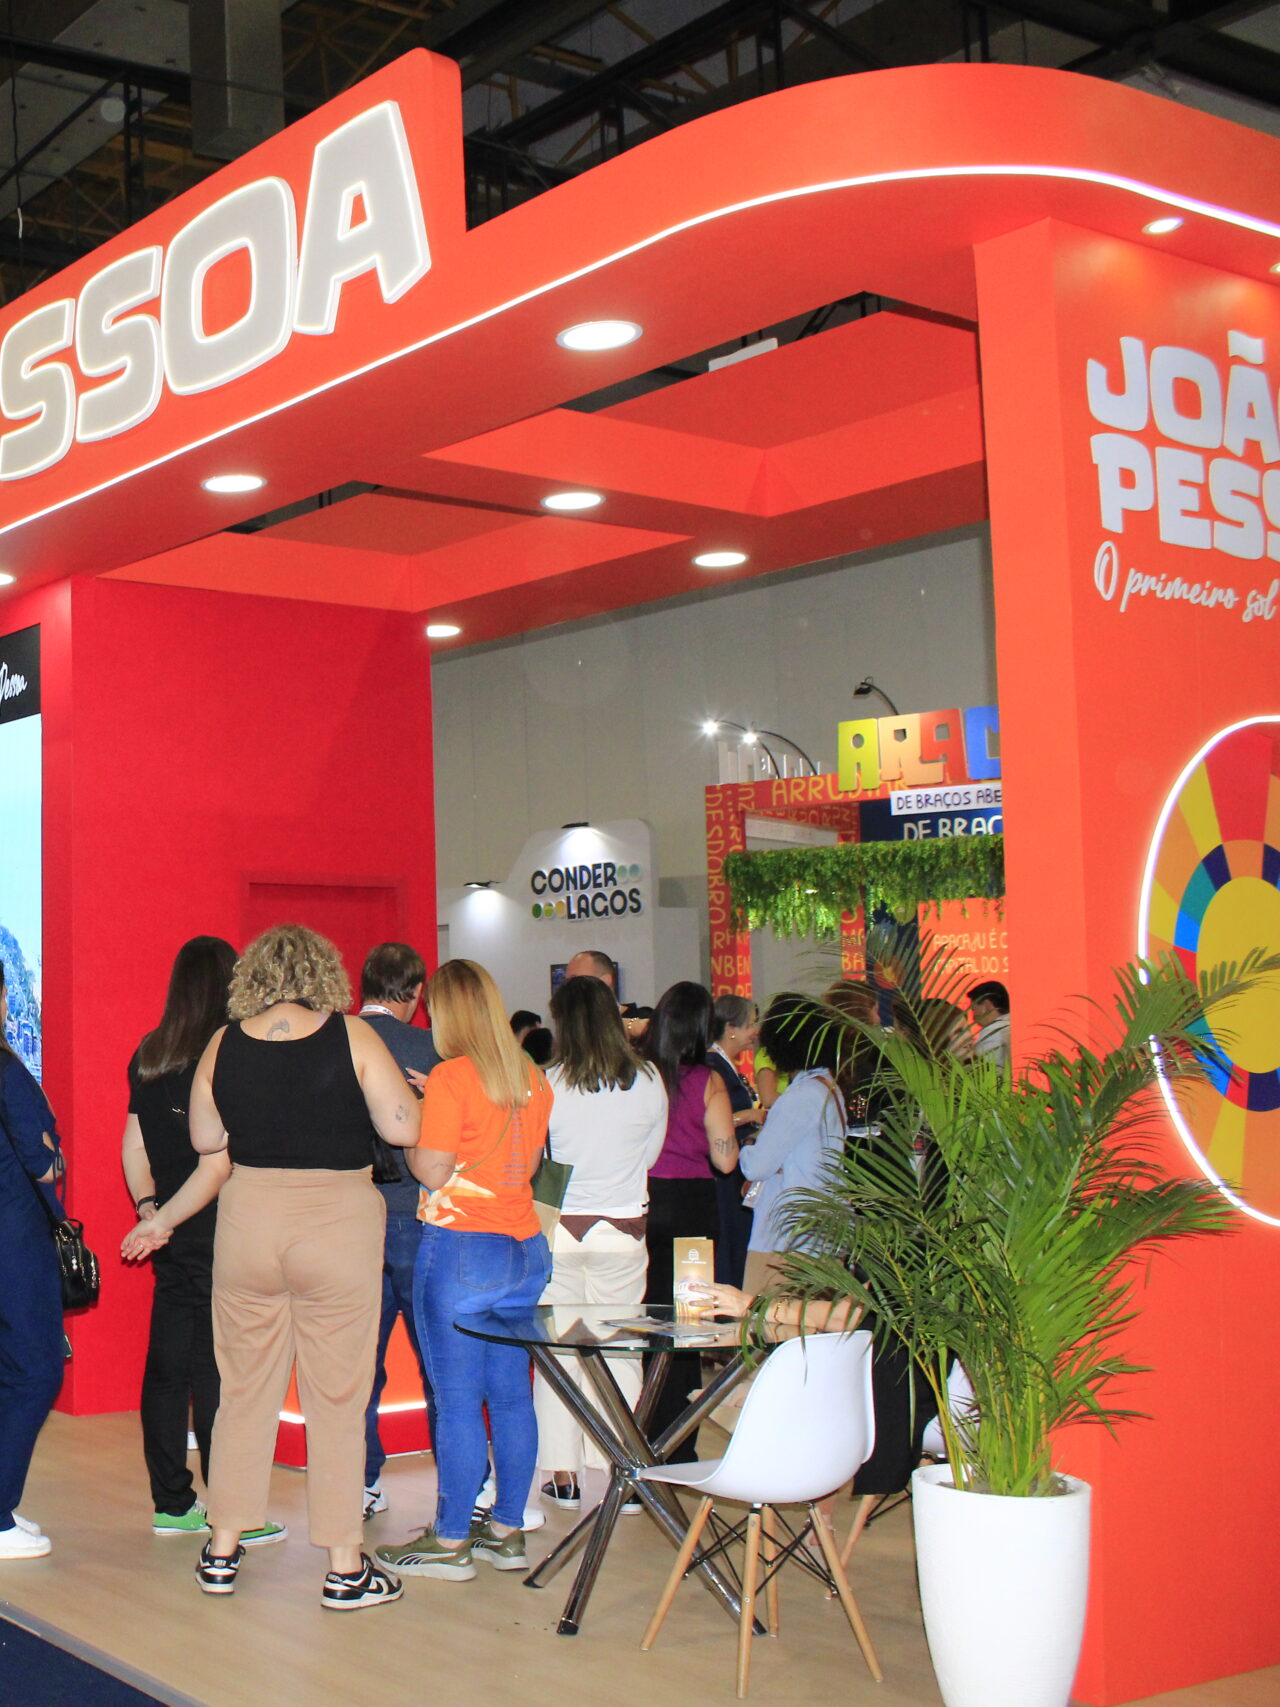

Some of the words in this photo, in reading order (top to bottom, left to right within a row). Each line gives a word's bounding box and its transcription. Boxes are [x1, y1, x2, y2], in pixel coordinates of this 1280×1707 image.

[1086, 329, 1280, 464] JOÃ
[1094, 540, 1118, 601] O
[1120, 567, 1240, 613] primeiro
[896, 796, 912, 810] DE
[915, 791, 971, 811] BRAÇOS
[531, 862, 618, 895] CONDER
[566, 888, 642, 919] LAGOS
